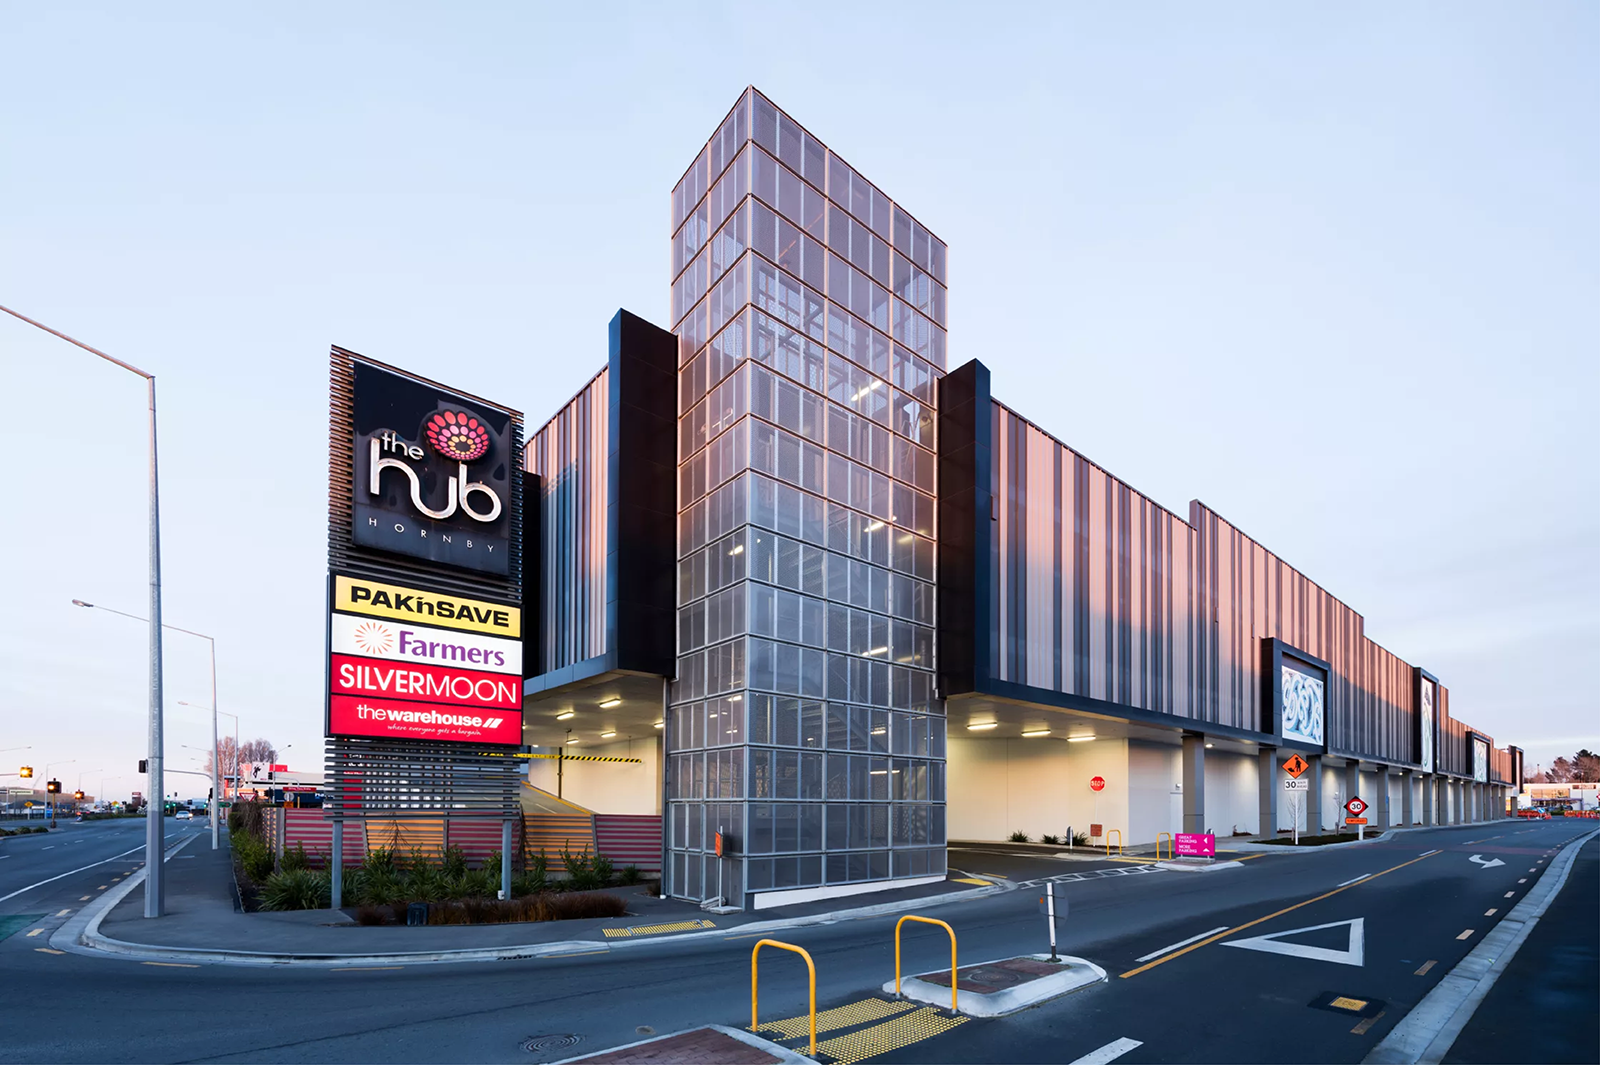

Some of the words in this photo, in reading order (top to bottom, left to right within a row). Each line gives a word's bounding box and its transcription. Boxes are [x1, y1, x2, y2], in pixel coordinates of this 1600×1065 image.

[381, 430, 425, 460] the
[369, 436, 502, 523] hub
[368, 517, 494, 553] HORNBY
[398, 630, 505, 667] Farmers
[339, 663, 516, 704] SILVERMOON
[387, 723, 407, 731] where
[408, 726, 436, 735] everyone
[437, 727, 450, 736] gets
[1285, 781, 1297, 789] 30
